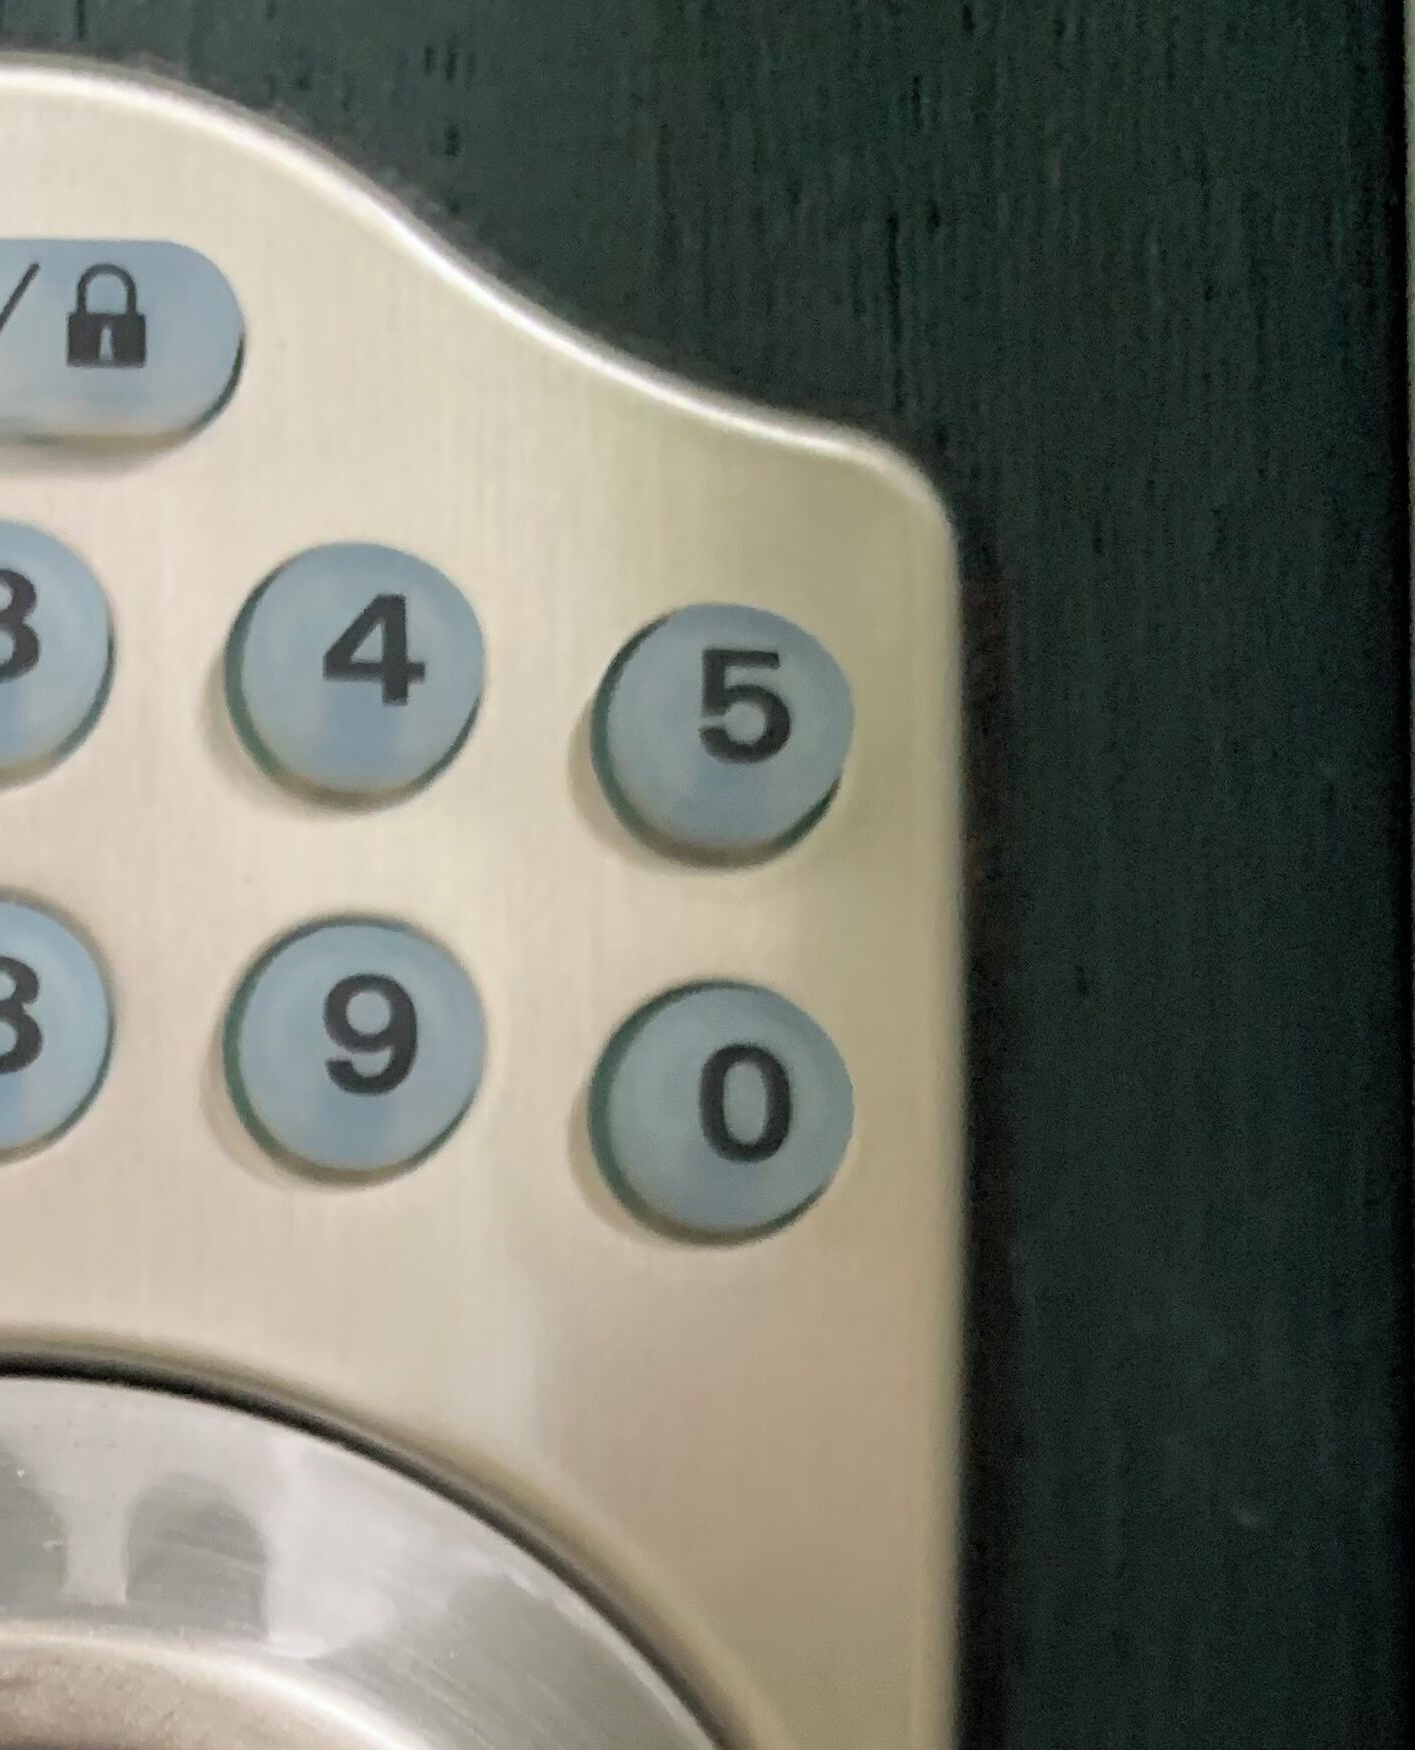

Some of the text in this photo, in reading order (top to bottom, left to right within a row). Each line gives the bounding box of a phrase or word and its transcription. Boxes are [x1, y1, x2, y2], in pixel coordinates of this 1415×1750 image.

[321, 592, 427, 708] 4
[698, 646, 794, 766] 5
[321, 972, 420, 1098] 9
[698, 1040, 795, 1165] 0
